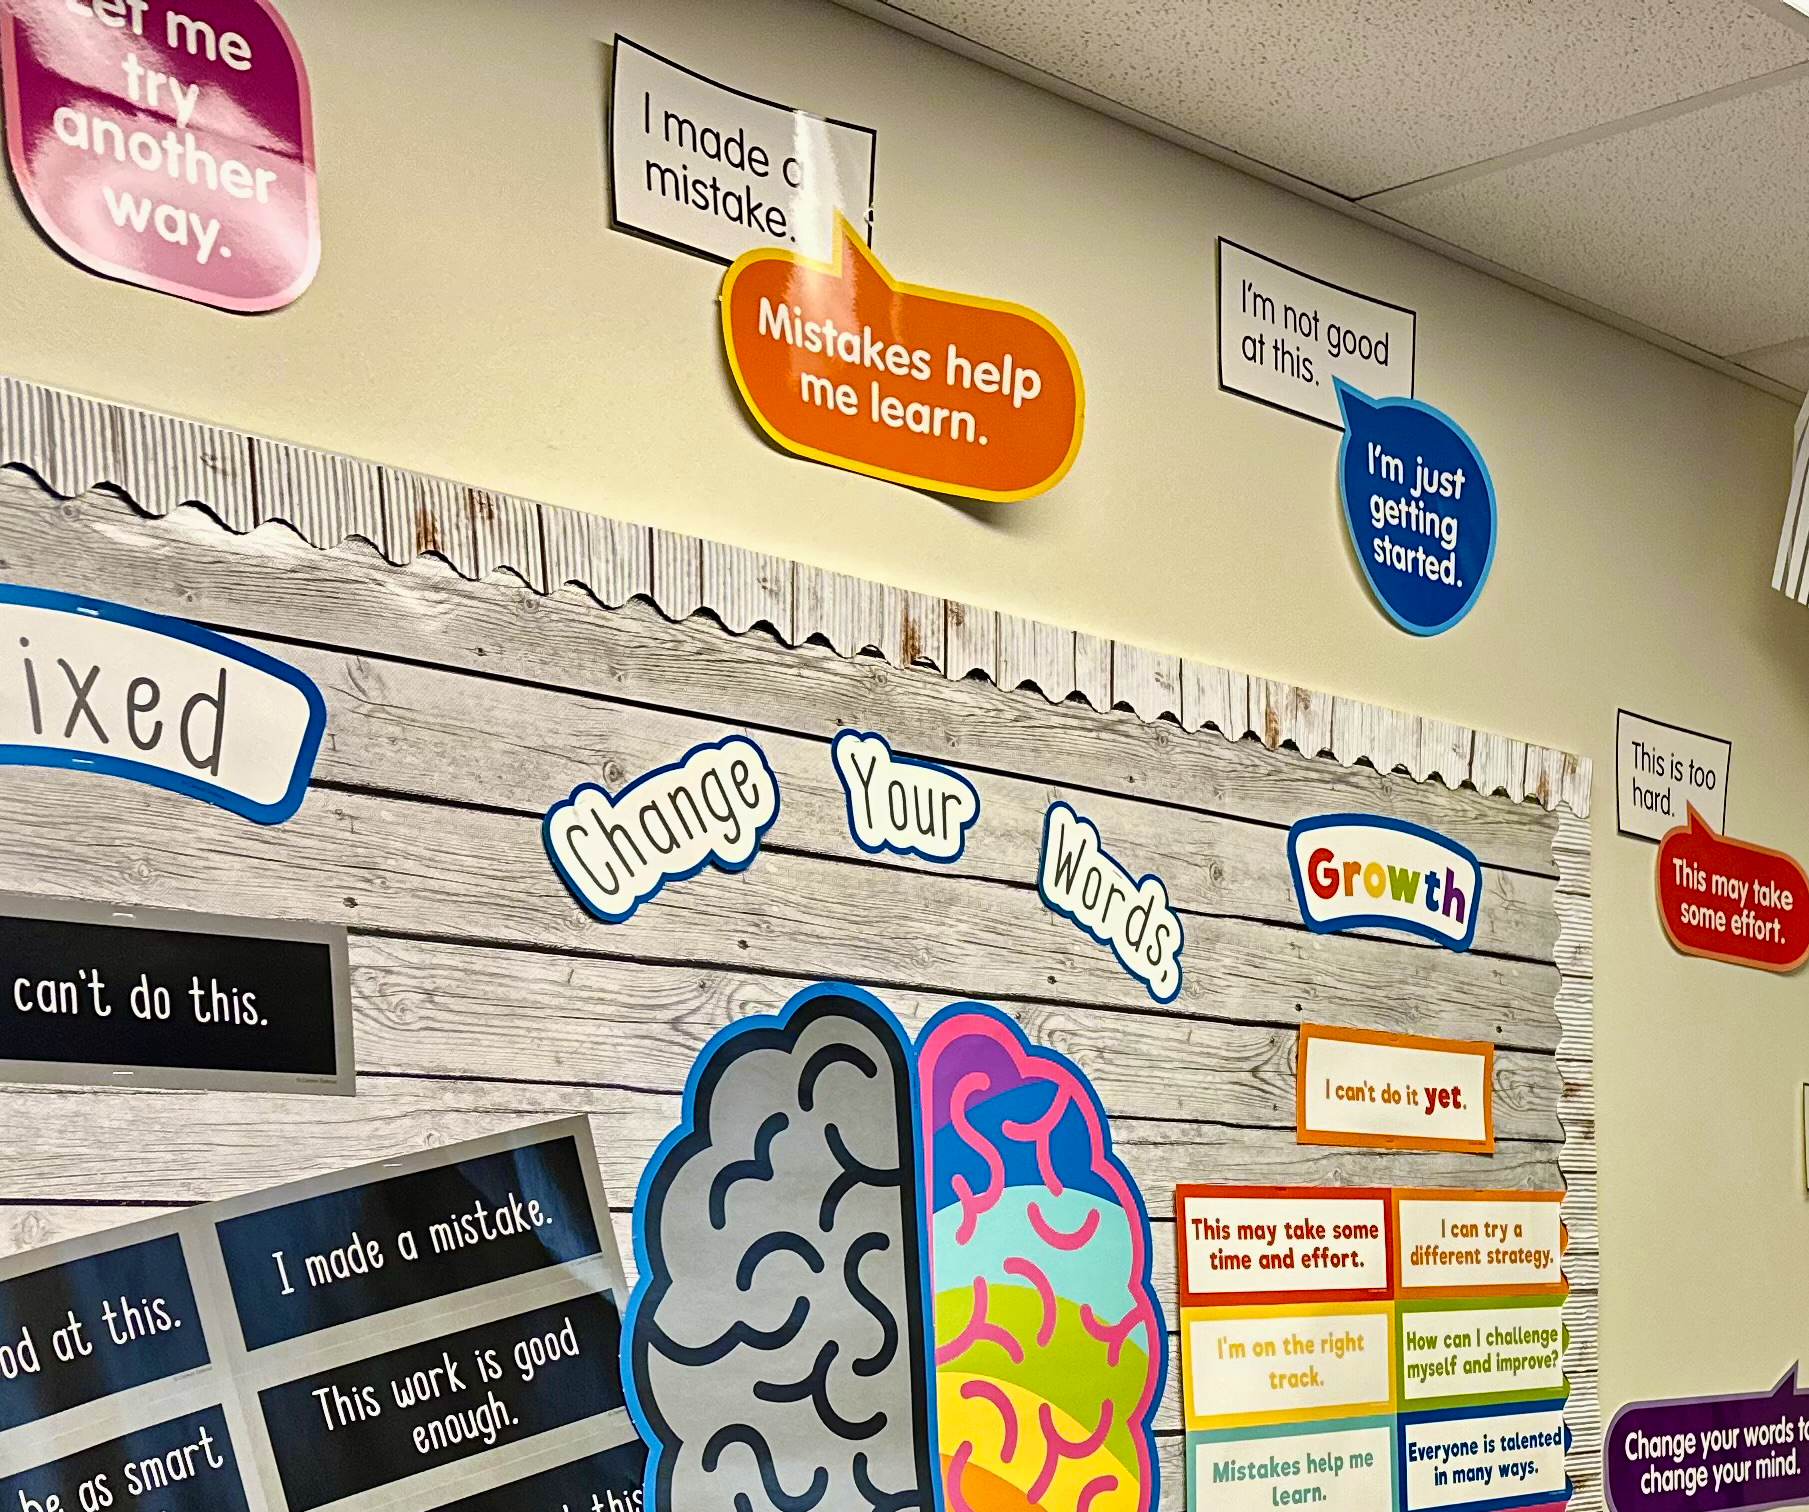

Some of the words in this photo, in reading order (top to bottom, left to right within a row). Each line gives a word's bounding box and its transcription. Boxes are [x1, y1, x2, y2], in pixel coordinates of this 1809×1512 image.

[121, 53, 199, 129] try
[53, 107, 277, 204] another
[643, 91, 650, 133] I
[663, 110, 769, 178] made
[782, 154, 805, 188] a
[102, 186, 232, 265] way.
[645, 159, 797, 243] mistake.
[1241, 279, 1275, 324] I'm
[1284, 304, 1320, 342] not
[1327, 324, 1390, 367] good
[758, 296, 931, 381] Mistakes
[946, 343, 1043, 408] help
[1241, 333, 1266, 365] at
[1272, 337, 1320, 386] this.
[800, 370, 859, 416] me
[871, 381, 989, 445] learn.
[1367, 442, 1404, 484] I'm
[1410, 455, 1465, 500] just
[1369, 493, 1458, 551] getting
[1373, 535, 1464, 588] started.
[1631, 740, 1666, 778] This
[1670, 752, 1684, 782] is
[1688, 758, 1717, 791] too
[850, 753, 961, 842] Your
[1632, 777, 1675, 818] hard.
[565, 757, 761, 896] Change
[1055, 822, 1171, 984] Words,
[1308, 847, 1466, 924] Growth
[1672, 857, 1707, 892] This
[1711, 870, 1749, 906] may
[1753, 879, 1794, 912] take
[1680, 903, 1727, 934] some
[1731, 907, 1786, 944] effort.
[1325, 1078, 1331, 1099] I
[1335, 1080, 1376, 1102] can't
[1381, 1083, 1402, 1105] do
[1406, 1085, 1419, 1106] it
[1424, 1086, 1467, 1116] yet.
[271, 1250, 295, 1296] I
[304, 1231, 385, 1288] made
[396, 1228, 419, 1261] a
[428, 1191, 553, 1256] mistake.
[1191, 1218, 1230, 1241] This
[1237, 1222, 1277, 1246] may
[1283, 1218, 1326, 1240] take
[1332, 1223, 1379, 1240] some
[1209, 1248, 1252, 1270] time
[1258, 1247, 1295, 1269] and
[1301, 1246, 1365, 1269] effort.
[1406, 1330, 1438, 1352] How
[1443, 1333, 1472, 1349] can
[1476, 1327, 1481, 1348] I
[1485, 1324, 1559, 1349] challenge
[1406, 1356, 1458, 1382] myself
[1463, 1353, 1492, 1374] and
[1495, 1348, 1559, 1378] improve?
[312, 1384, 382, 1433] This
[390, 1352, 467, 1410] work
[474, 1346, 504, 1384] is
[513, 1316, 580, 1382] good
[412, 1393, 521, 1456] enough.
[1408, 1438, 1479, 1464] Everyone
[1483, 1433, 1496, 1454] is
[1500, 1426, 1562, 1452] talented
[1625, 1429, 1696, 1463] Change
[1700, 1427, 1740, 1460] your
[1744, 1415, 1794, 1447] words
[1212, 1457, 1301, 1483] Mistakes
[1306, 1451, 1344, 1476] help
[1349, 1449, 1374, 1469] me
[1434, 1465, 1448, 1487] in
[1452, 1465, 1493, 1487] many
[1498, 1459, 1540, 1480] ways.
[1640, 1464, 1708, 1497] change
[1712, 1459, 1751, 1493] your
[1755, 1447, 1801, 1480] mind.
[1272, 1484, 1327, 1507] learn.
